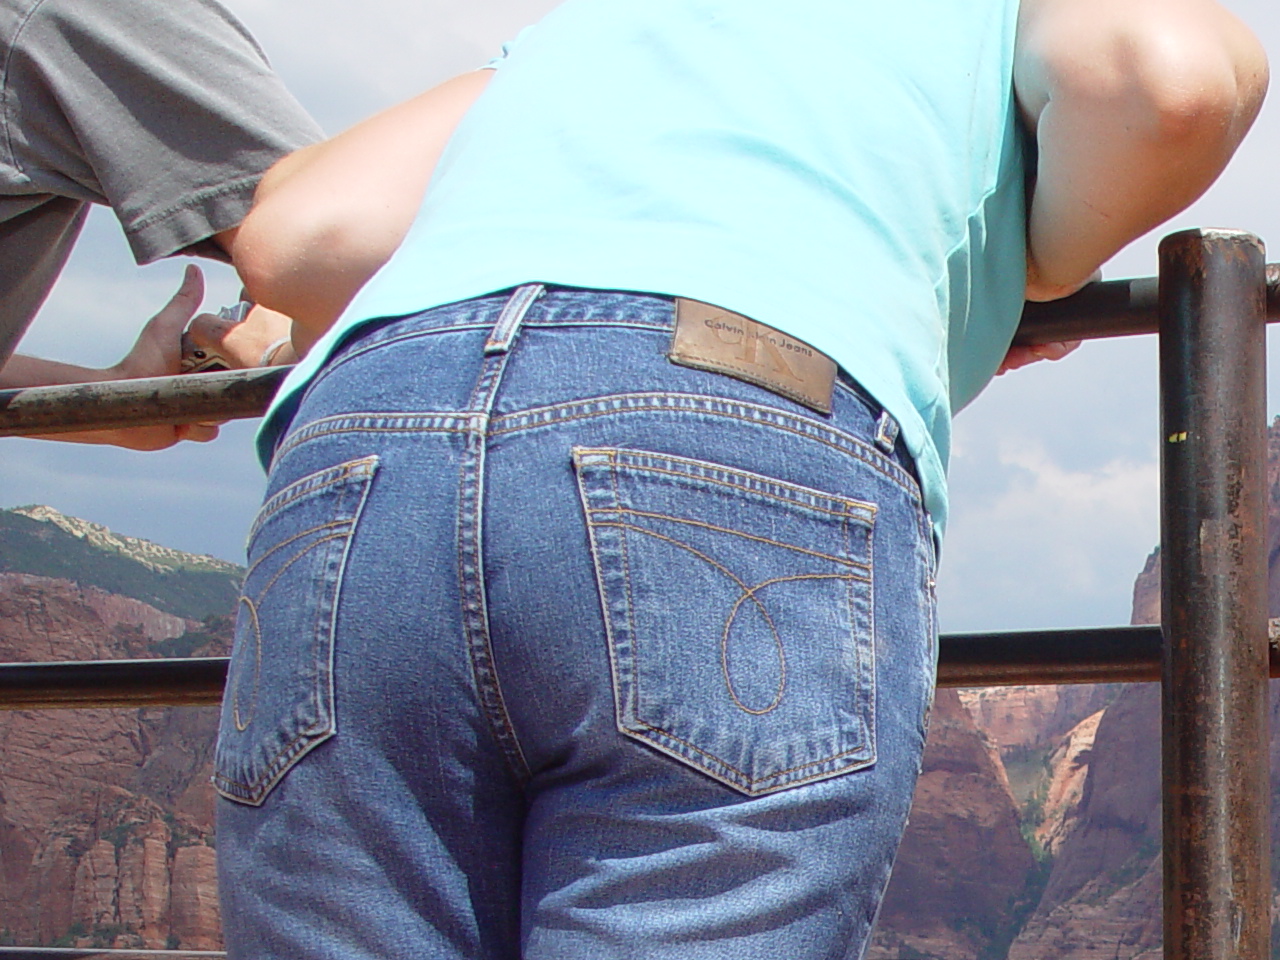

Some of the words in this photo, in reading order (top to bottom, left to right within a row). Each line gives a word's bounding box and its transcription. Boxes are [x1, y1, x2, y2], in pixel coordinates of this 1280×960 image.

[704, 319, 744, 336] Calvin
[747, 327, 776, 345] lin
[780, 338, 813, 357] Jeans
